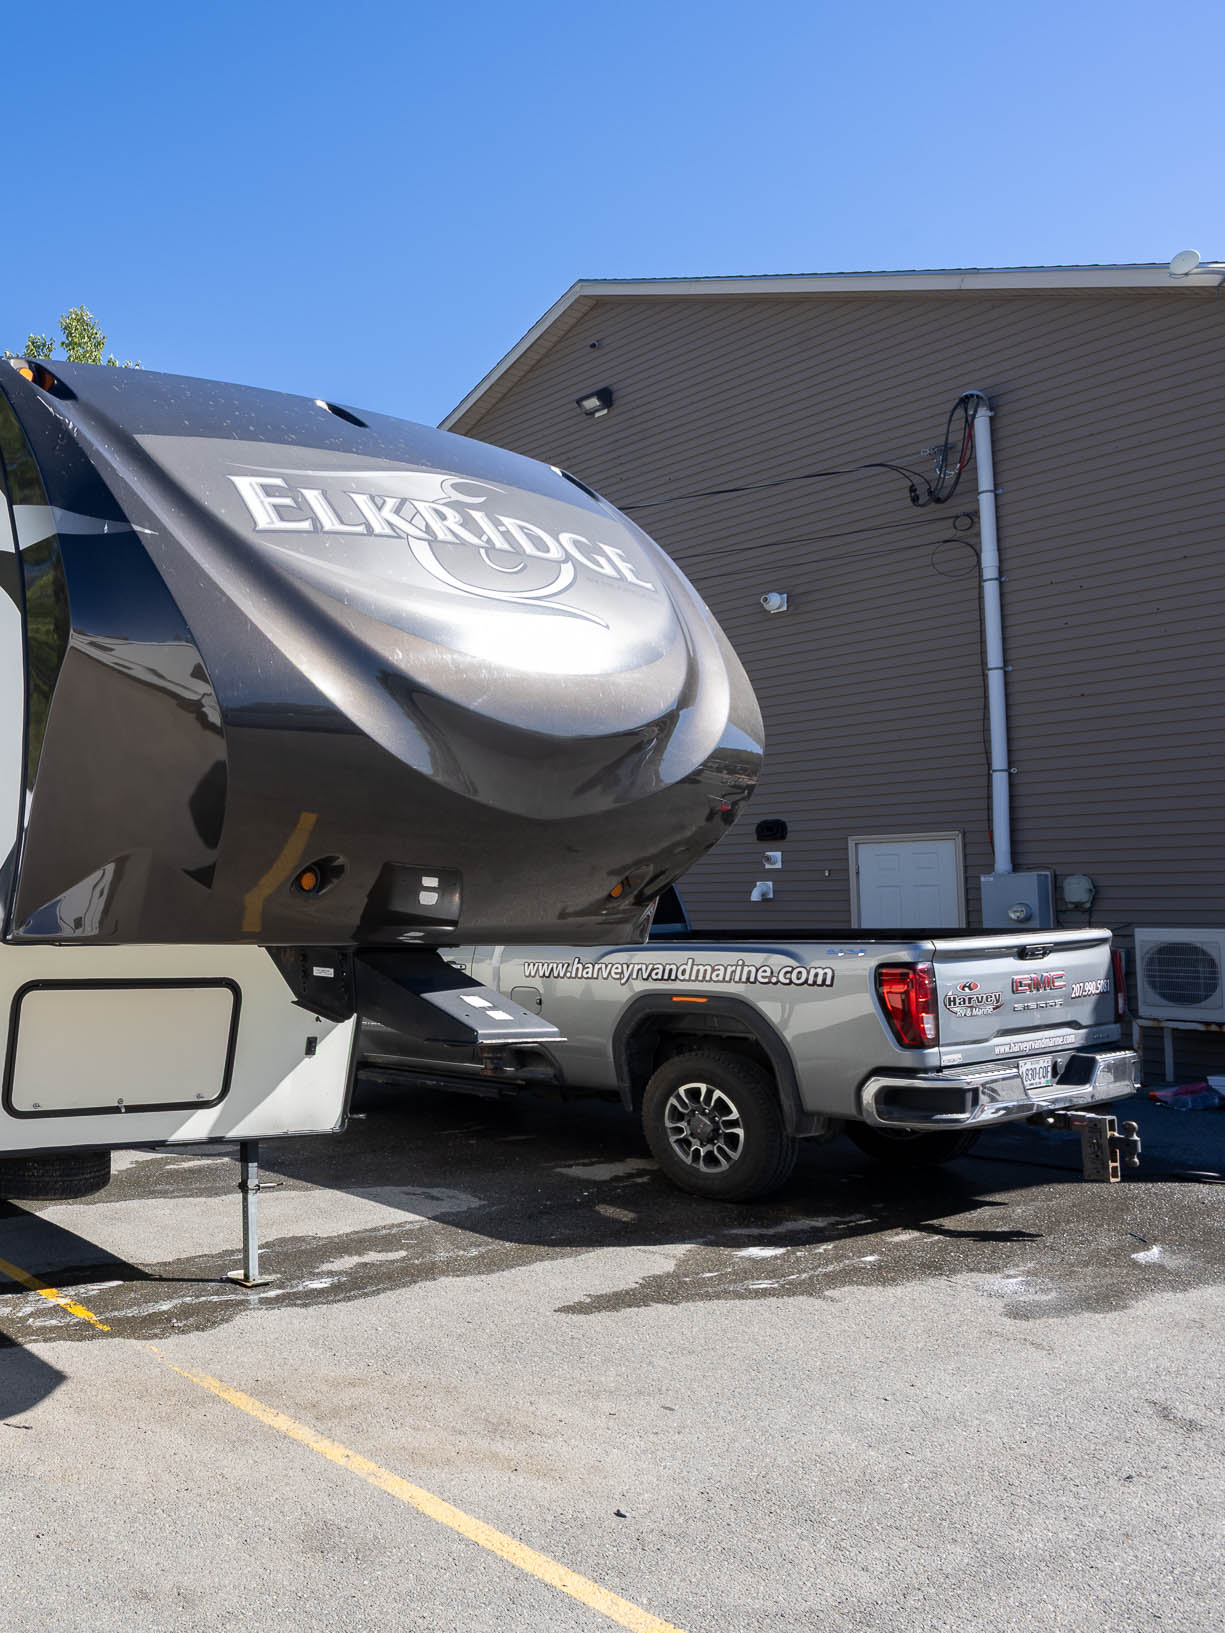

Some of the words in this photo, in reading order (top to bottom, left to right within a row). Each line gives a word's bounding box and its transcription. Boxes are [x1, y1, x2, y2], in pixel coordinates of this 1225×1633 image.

[225, 473, 657, 593] ELKRIDGE
[523, 957, 835, 988] www.harveyrvandmarine.com
[1011, 970, 1066, 994] GMC
[947, 992, 1002, 1007] Harvey
